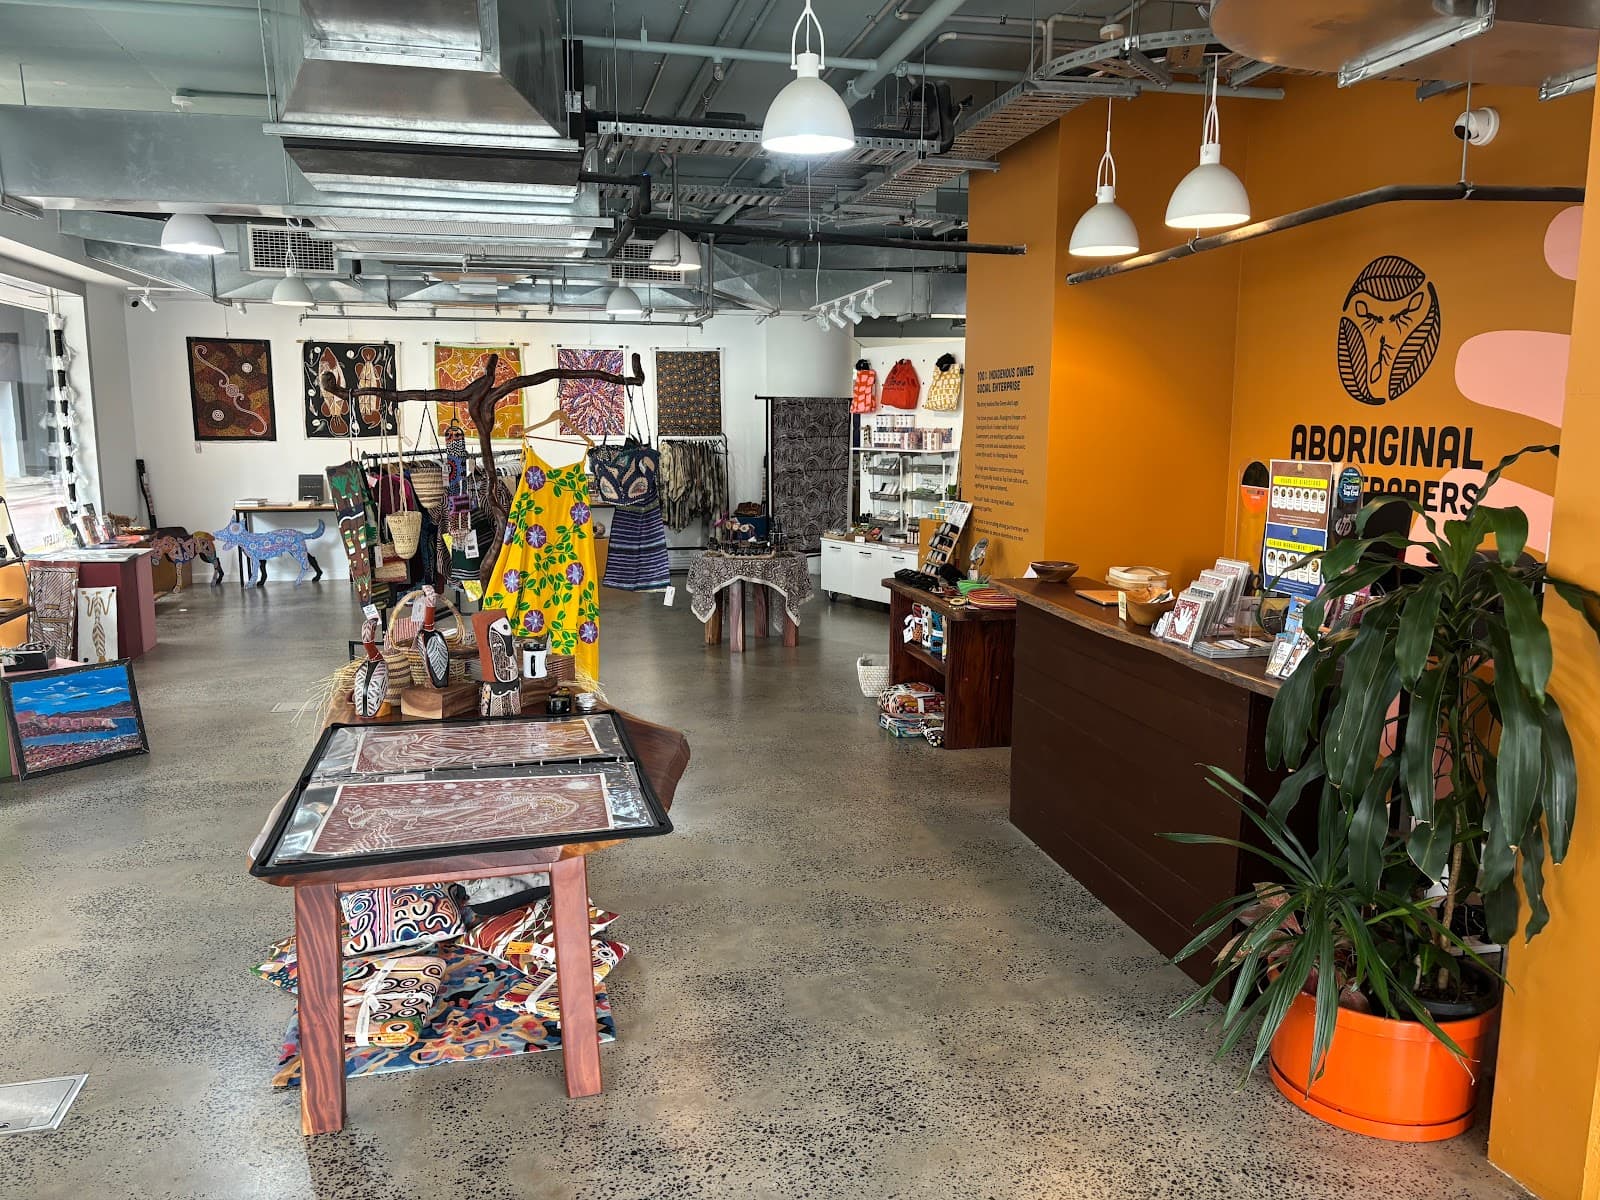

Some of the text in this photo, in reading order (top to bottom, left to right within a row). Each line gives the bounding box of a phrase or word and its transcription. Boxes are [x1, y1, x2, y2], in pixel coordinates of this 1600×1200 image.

[1016, 365, 1034, 377] OWNED
[992, 380, 1020, 392] ENTERPRISE
[1291, 424, 1483, 470] ABORIGINAL
